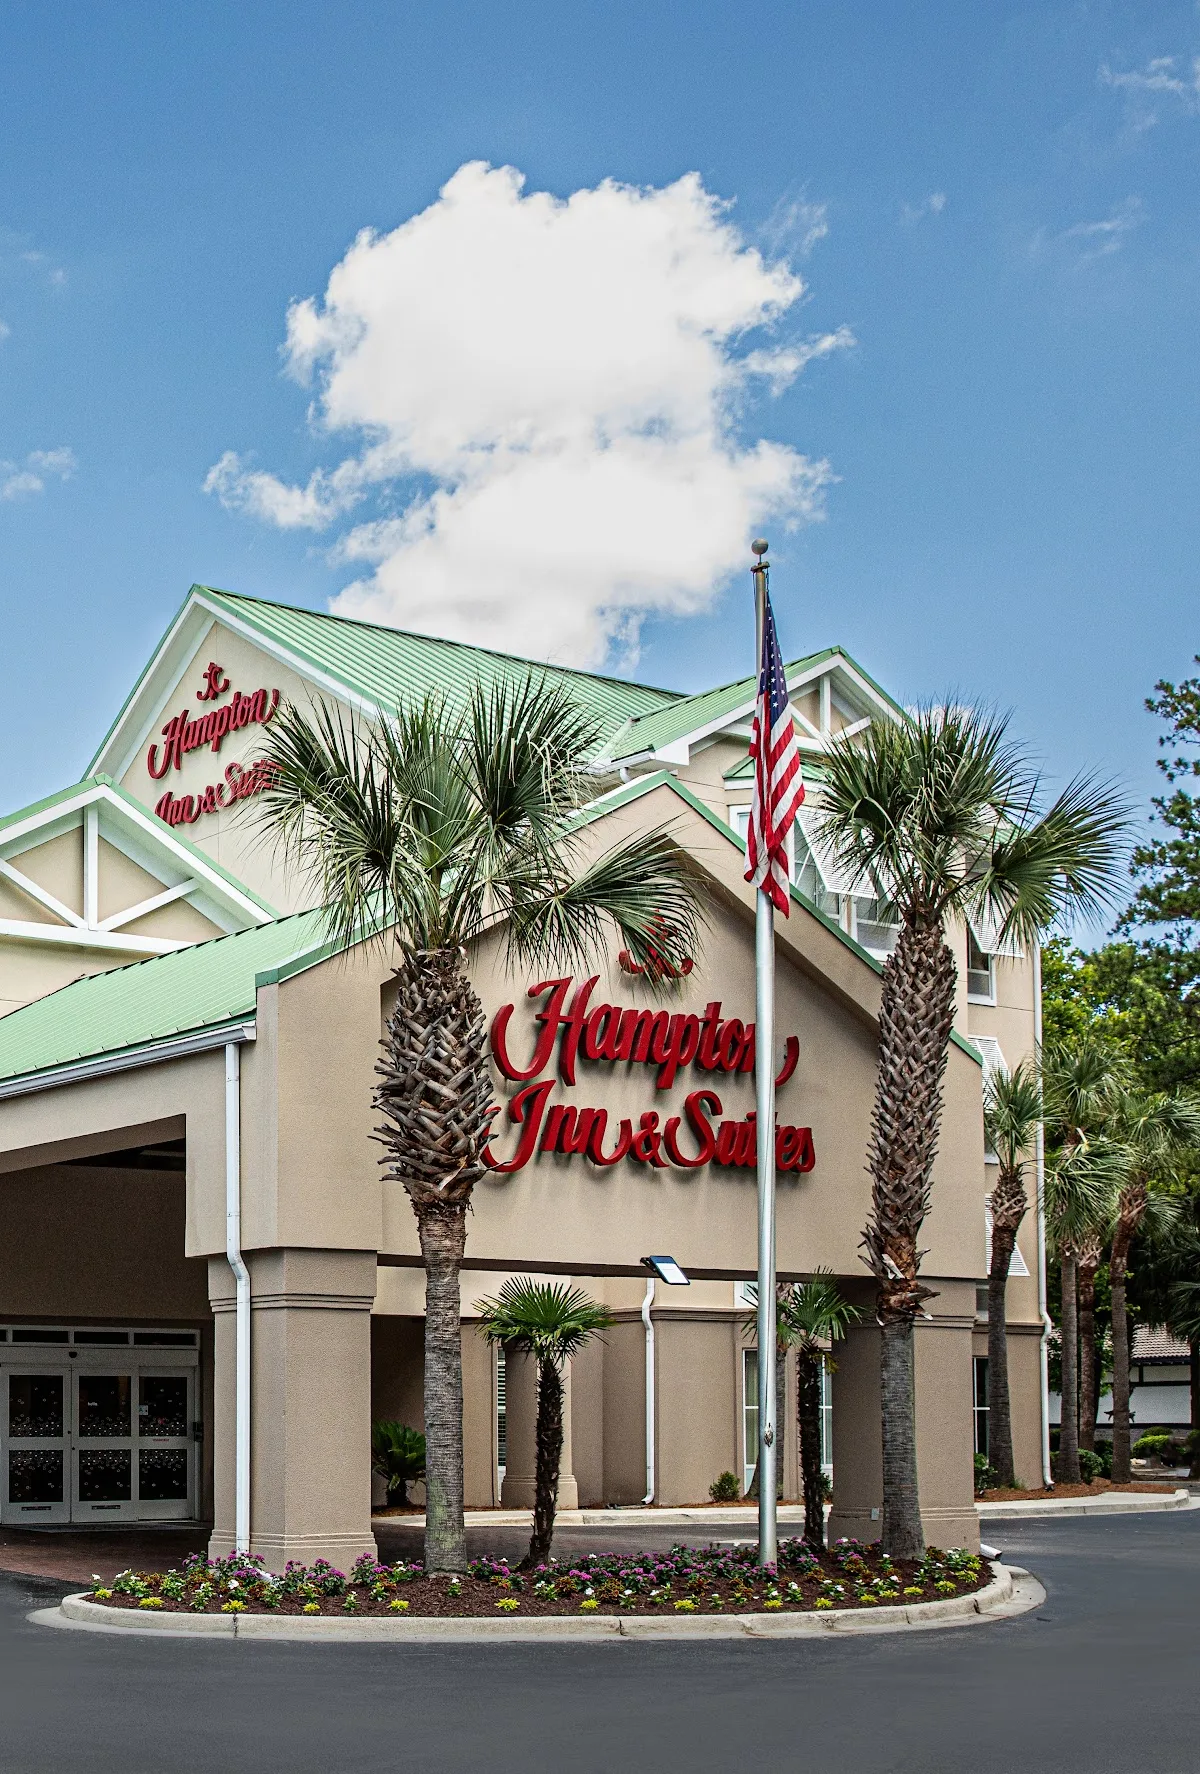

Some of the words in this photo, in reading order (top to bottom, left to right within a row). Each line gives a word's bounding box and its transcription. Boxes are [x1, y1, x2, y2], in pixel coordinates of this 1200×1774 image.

[147, 689, 280, 779] Hampton
[155, 791, 202, 828] Inn
[480, 1079, 632, 1173] Inn
[664, 1090, 816, 1173] Suies
